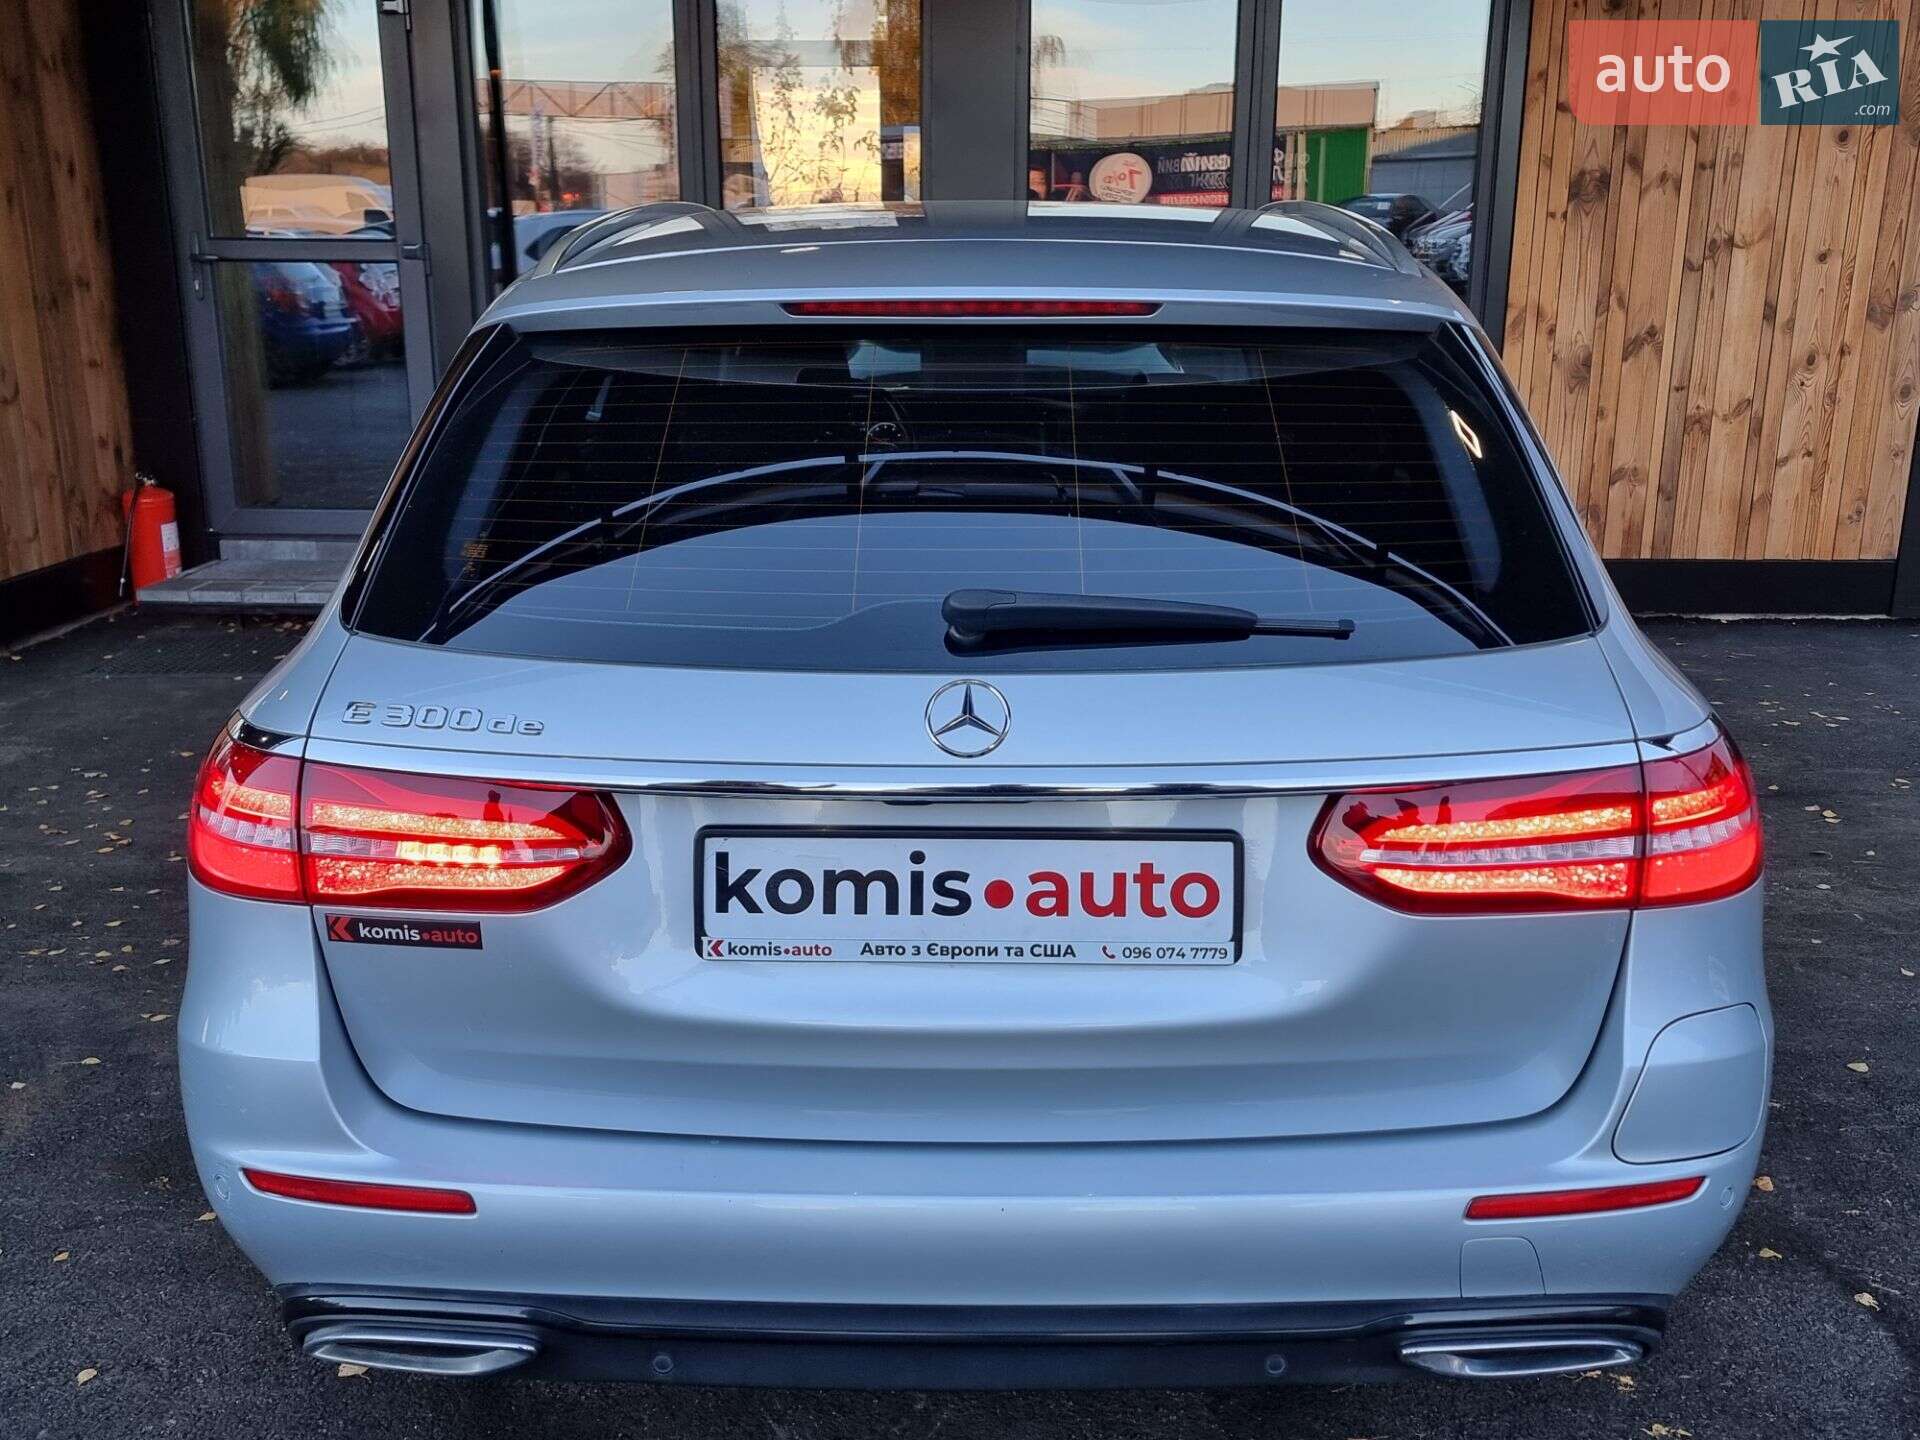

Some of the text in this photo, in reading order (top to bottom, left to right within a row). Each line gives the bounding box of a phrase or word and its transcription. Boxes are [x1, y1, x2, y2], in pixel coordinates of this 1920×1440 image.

[341, 701, 545, 736] E 300 de
[860, 942, 907, 957] Авто
[926, 943, 999, 960] Європи
[1004, 946, 1025, 958] та
[1029, 943, 1077, 958] США
[1121, 946, 1228, 960] 096 074 7779
